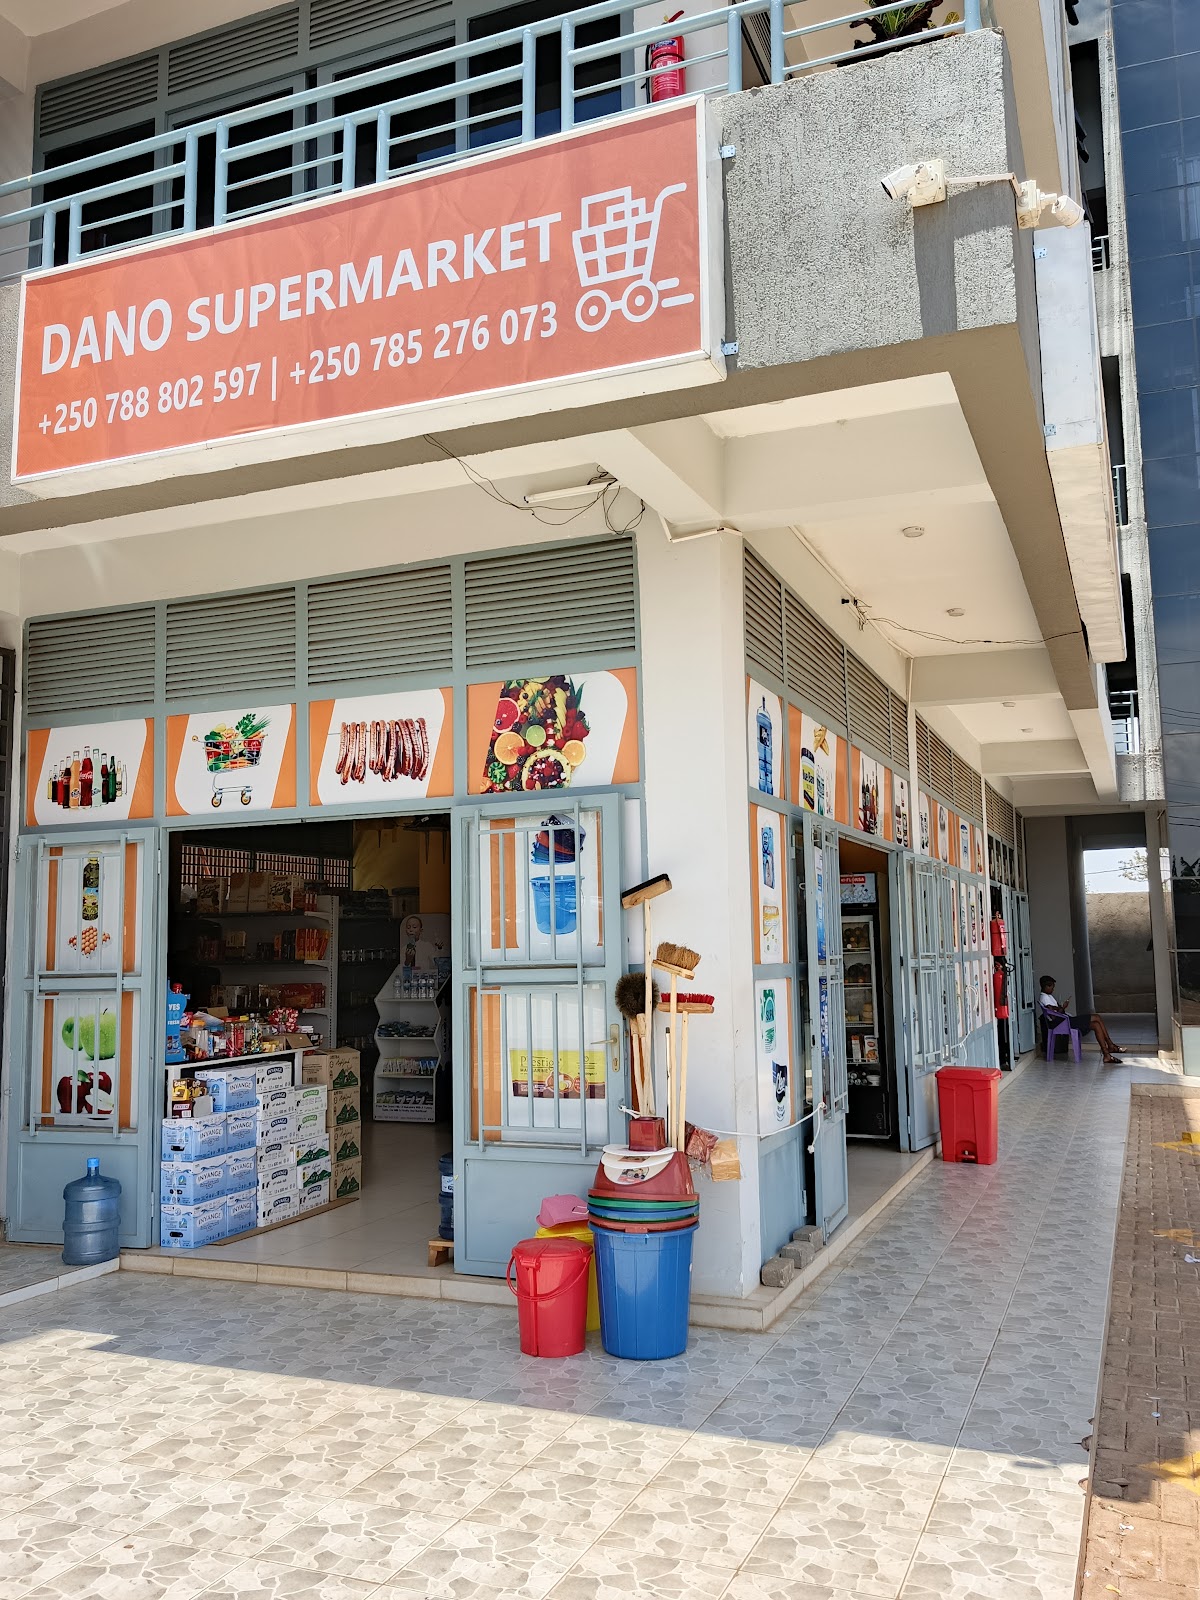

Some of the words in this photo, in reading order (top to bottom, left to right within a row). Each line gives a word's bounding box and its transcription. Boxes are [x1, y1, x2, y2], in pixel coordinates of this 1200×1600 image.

[41, 298, 173, 375] DANO
[186, 212, 562, 342] SUPERMARKET
[38, 397, 98, 435] +250
[105, 386, 150, 424] 788
[157, 375, 204, 413] 802
[213, 362, 262, 402] 597
[289, 342, 361, 385] +250
[370, 328, 423, 371] 785
[433, 314, 490, 359] 276
[500, 301, 558, 345] 073
[168, 1003, 181, 1011] YES
[168, 1011, 180, 1020] TO
[520, 1056, 559, 1071] Pestig
[231, 1121, 253, 1132] INYANGE
[200, 1128, 221, 1139] INYANGE
[231, 1162, 253, 1173] INYANGE
[198, 1170, 221, 1182] INYANGE
[232, 1202, 252, 1213] INYANGE
[198, 1212, 221, 1225] INYANGE
